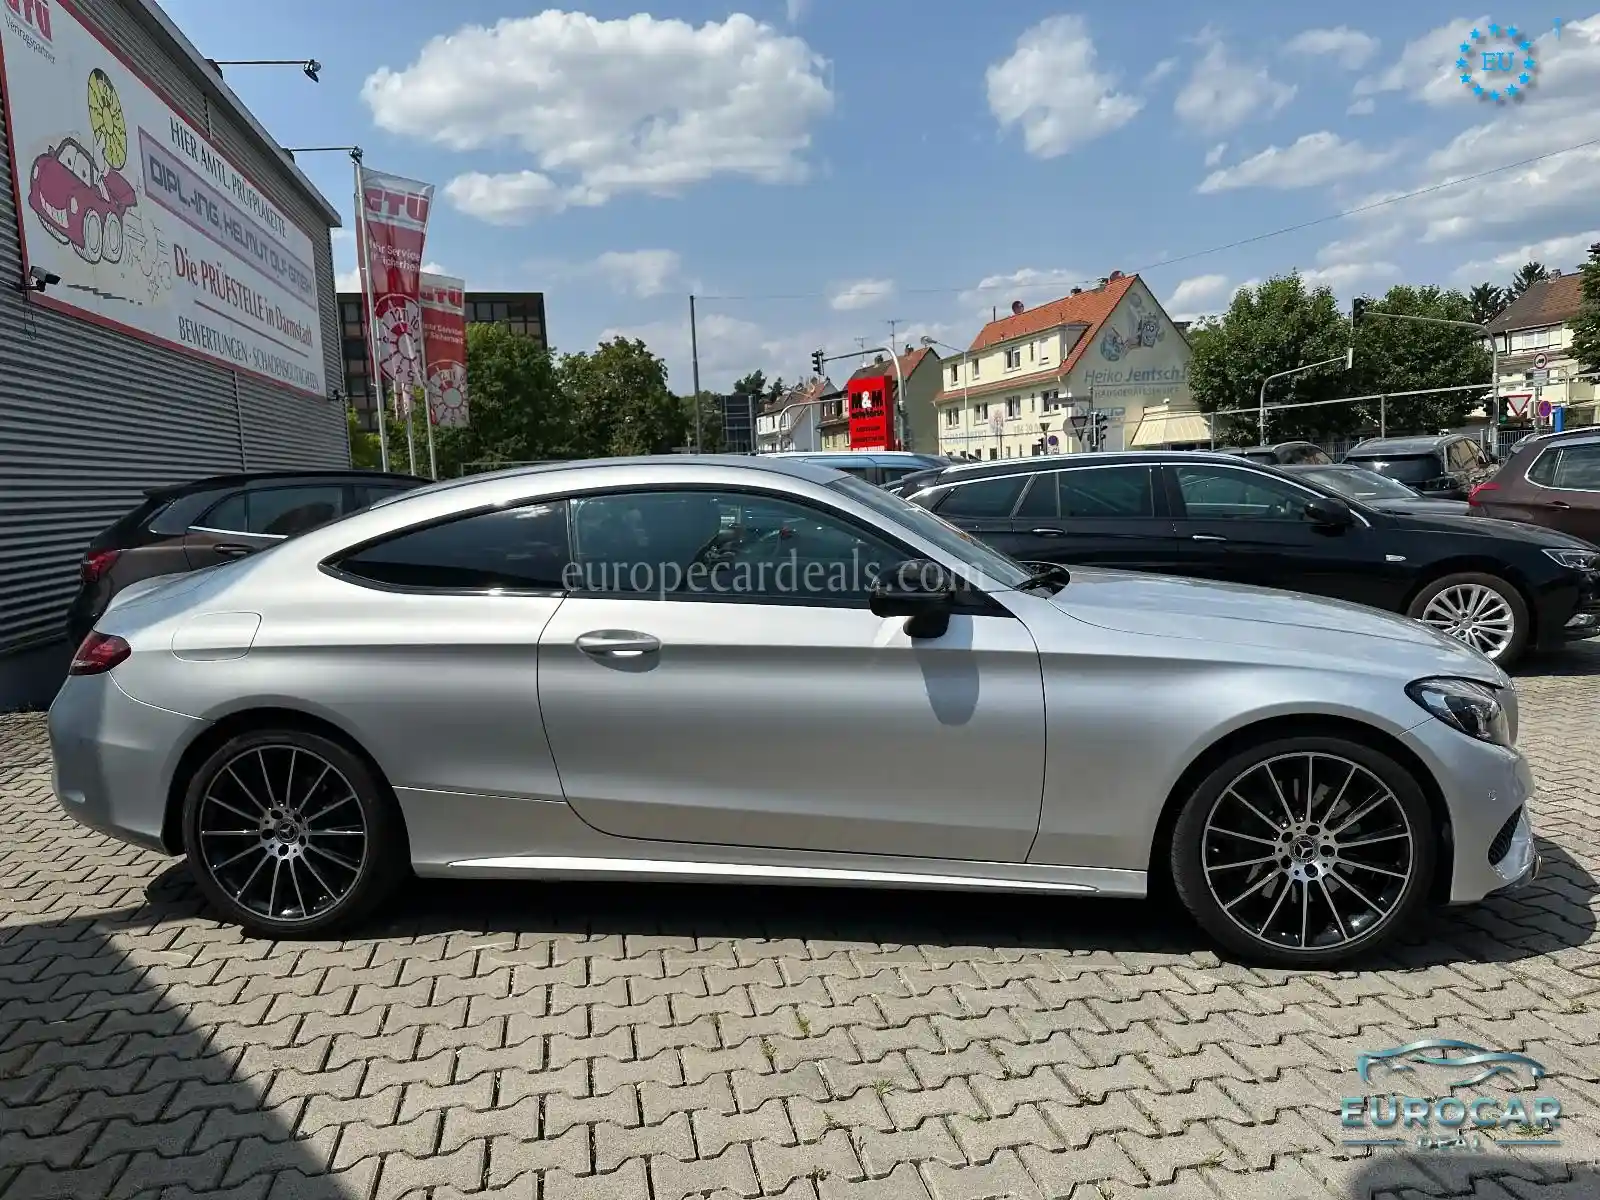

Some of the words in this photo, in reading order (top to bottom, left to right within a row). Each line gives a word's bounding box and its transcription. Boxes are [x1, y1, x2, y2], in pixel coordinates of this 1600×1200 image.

[170, 116, 199, 163] HIER
[387, 245, 421, 261] Service
[173, 243, 197, 286] Die
[200, 260, 265, 322] PRÜFSTELLE
[178, 315, 248, 364] BEWERTUNGEN
[1085, 368, 1122, 384] Heiko
